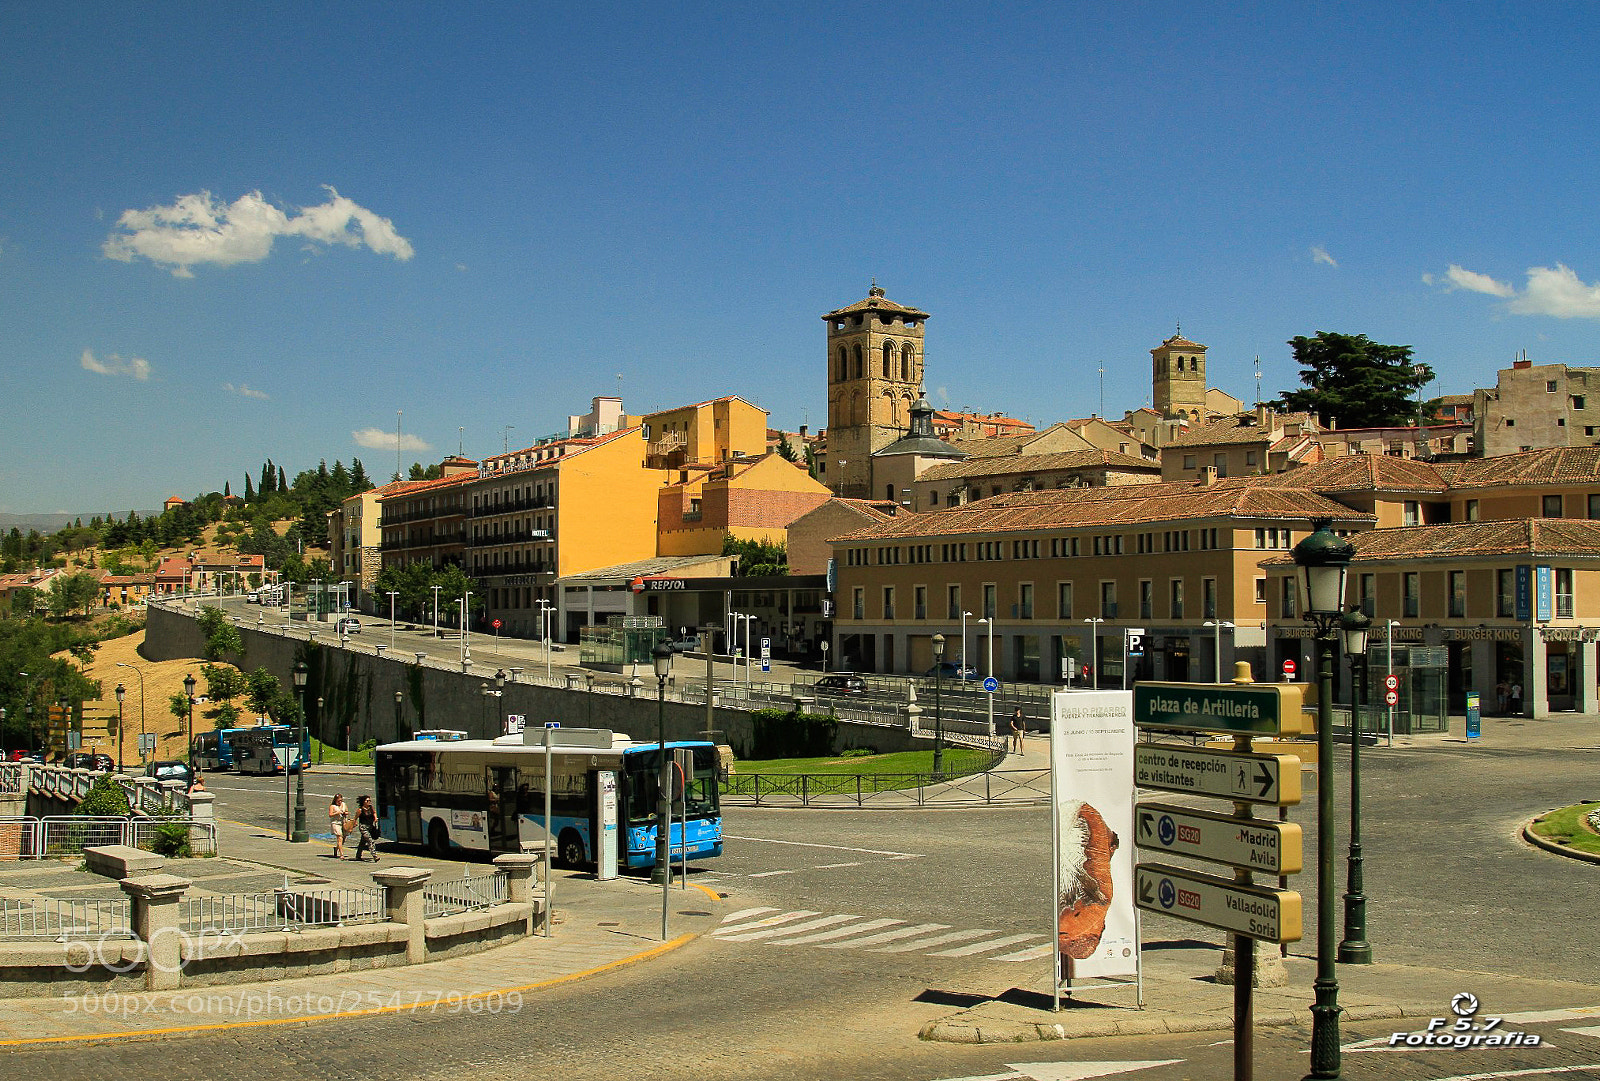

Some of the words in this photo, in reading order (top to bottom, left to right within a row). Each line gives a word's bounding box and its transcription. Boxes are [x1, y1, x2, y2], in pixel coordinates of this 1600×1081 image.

[651, 580, 686, 590] REPSOL
[1286, 628, 1315, 638] BURGER
[1401, 628, 1423, 639] KING
[1455, 628, 1492, 640] BURGER
[1494, 628, 1520, 640] KING
[762, 639, 769, 648] P
[1129, 635, 1141, 651] P
[1149, 695, 1180, 715] plaza
[1183, 696, 1198, 714] de
[1202, 697, 1259, 719] Artillería
[1138, 753, 1166, 767] centro
[1168, 755, 1179, 768] de
[1181, 757, 1227, 774] recepción
[1138, 768, 1149, 781] de
[1151, 770, 1195, 787] visitantes
[1179, 827, 1200, 842] SG20
[1240, 829, 1276, 848] Madrid
[1250, 849, 1276, 866] Avila
[1178, 892, 1200, 909] SG20
[1225, 894, 1276, 920] Valladolid
[1249, 918, 1276, 938] Soria
